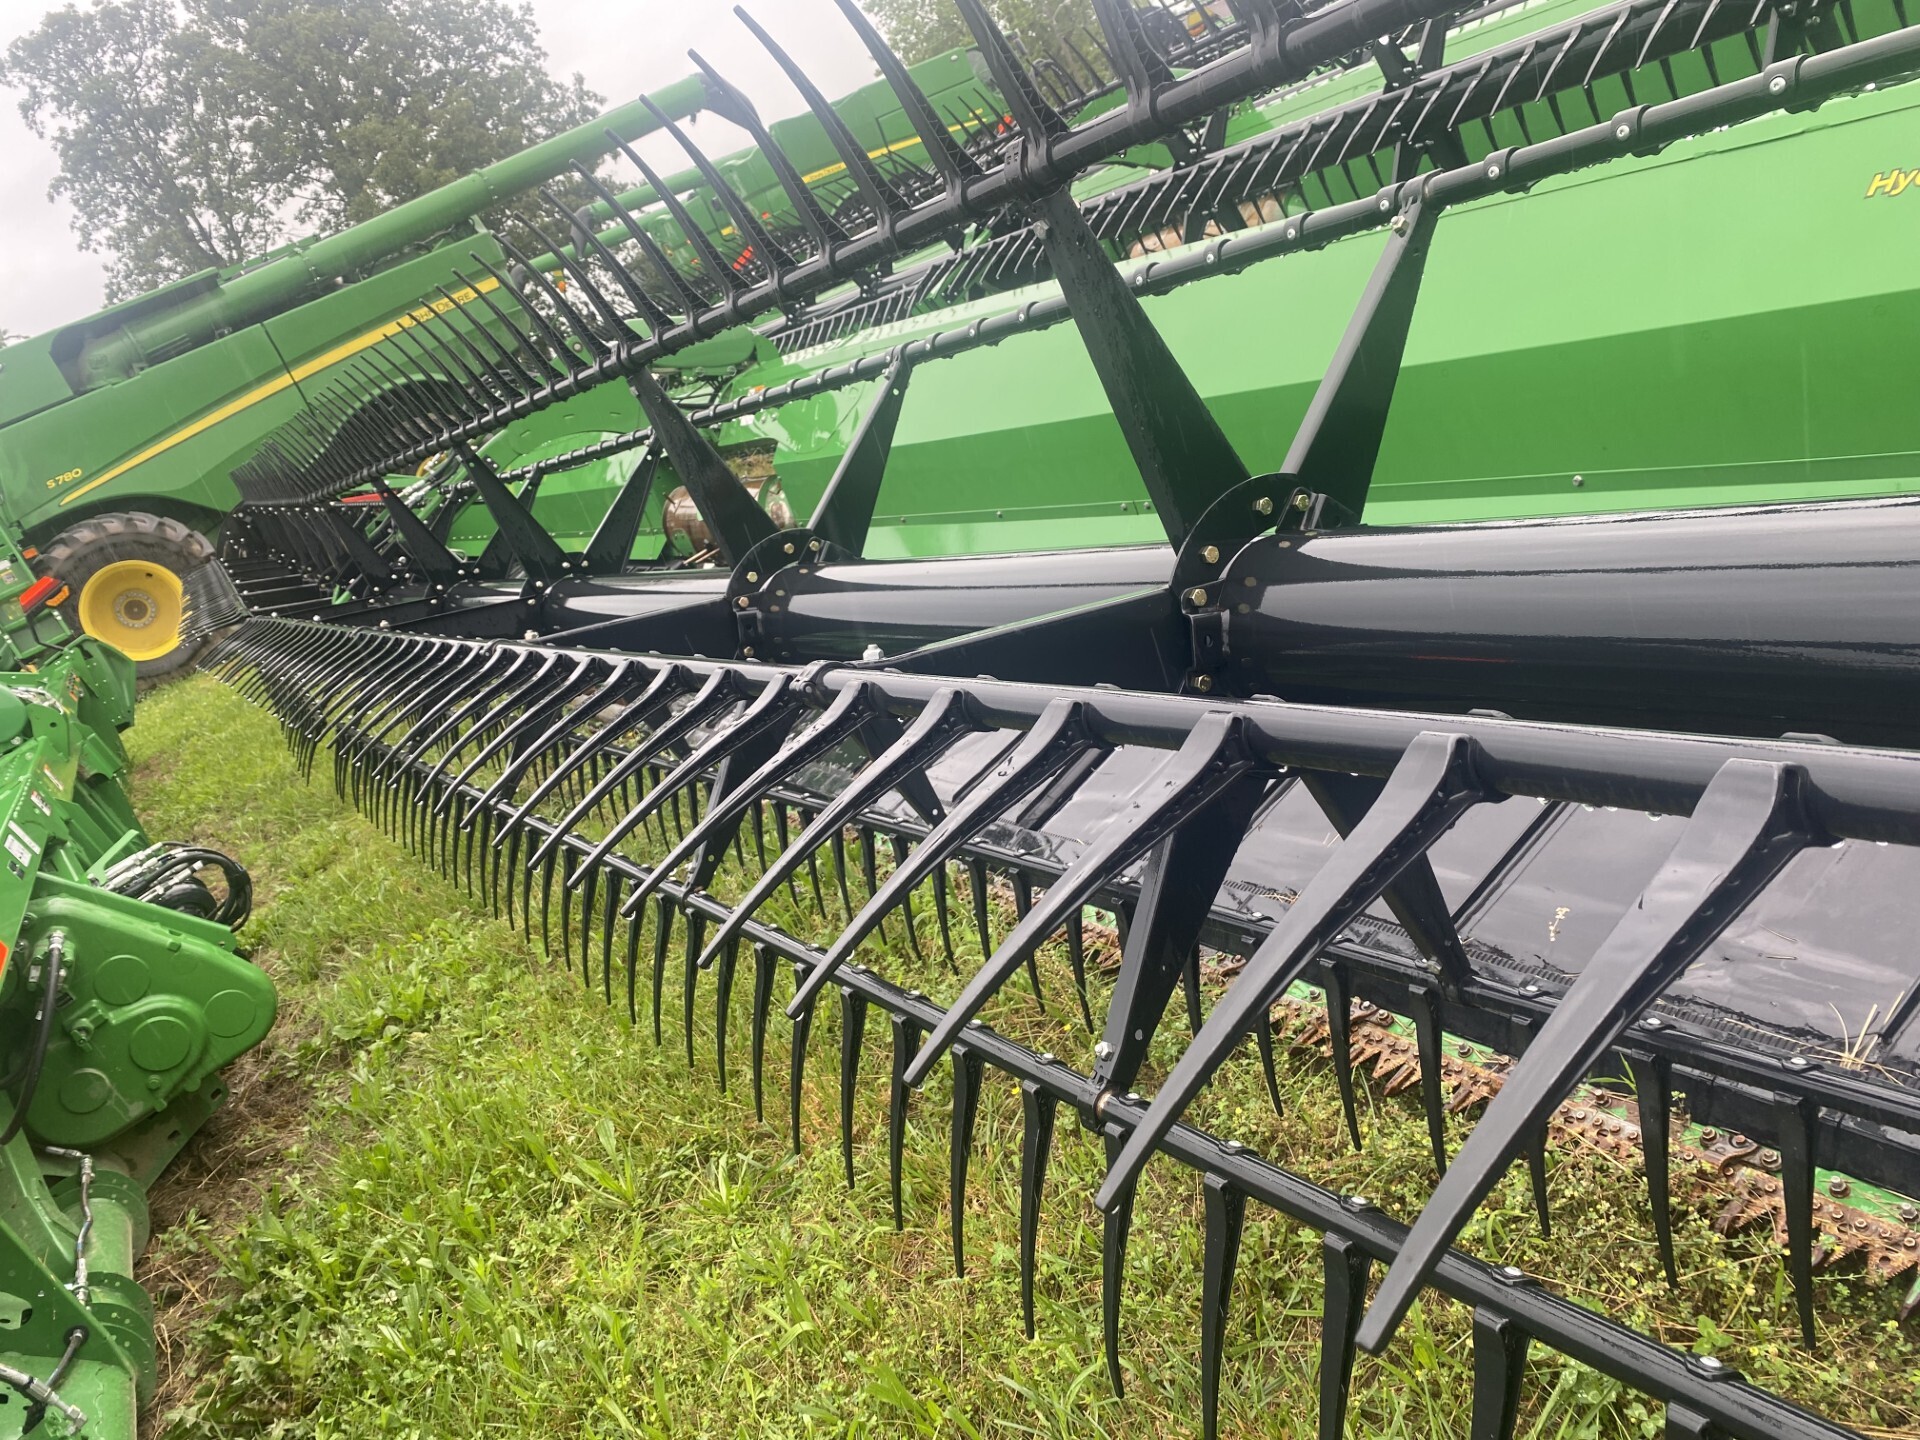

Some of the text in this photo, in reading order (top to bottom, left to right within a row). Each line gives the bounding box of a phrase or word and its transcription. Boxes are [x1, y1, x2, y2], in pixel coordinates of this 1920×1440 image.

[1864, 167, 1920, 199] Hy
[436, 291, 471, 312] DERE
[46, 467, 82, 489] S780
